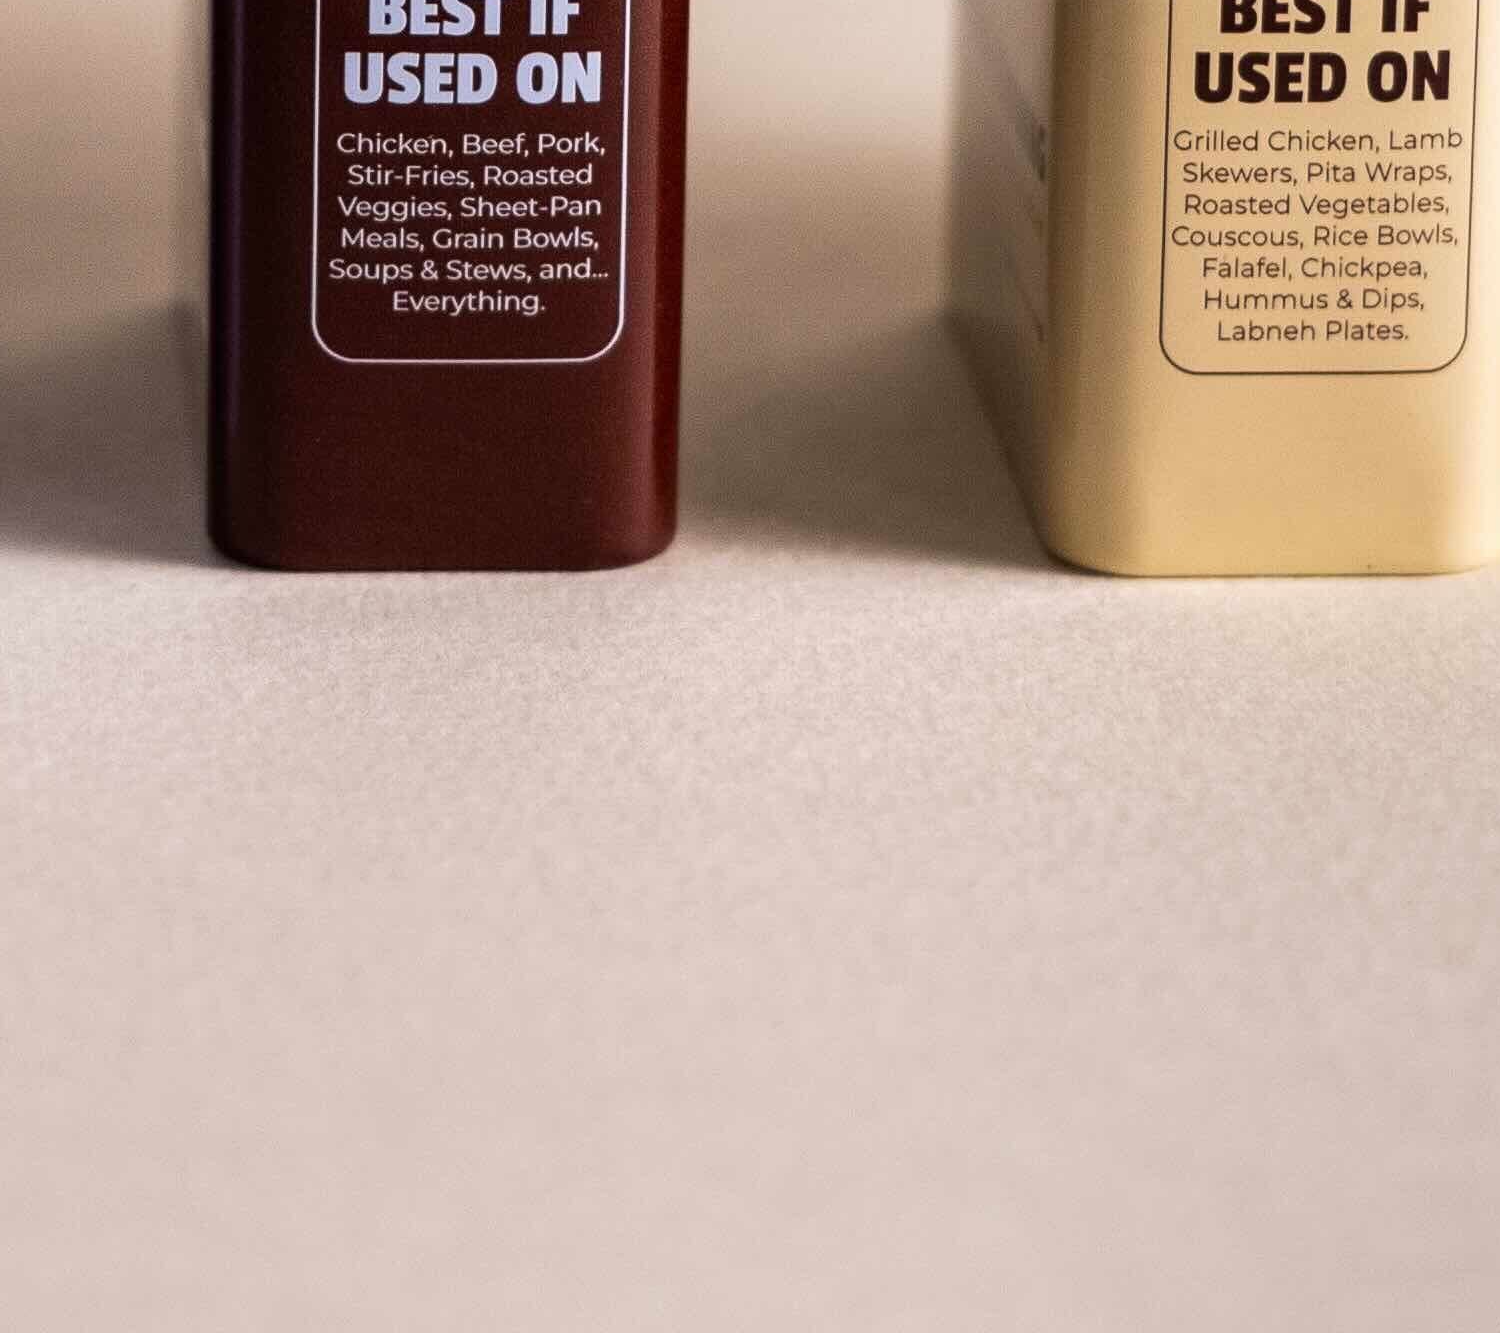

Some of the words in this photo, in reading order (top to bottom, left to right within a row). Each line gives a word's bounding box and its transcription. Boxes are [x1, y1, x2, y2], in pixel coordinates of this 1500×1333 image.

[343, 51, 498, 105] USED
[515, 51, 602, 105] ON
[1193, 51, 1348, 104] USED
[1366, 49, 1451, 103] ON
[336, 132, 454, 158] Chicken,
[462, 132, 529, 158] Beef,
[537, 131, 606, 156] Pork,
[1173, 129, 1259, 152] Grilled
[1267, 129, 1380, 154] Chicken,
[1389, 127, 1463, 151] Lamb
[347, 163, 475, 189] Stir-Fries,
[483, 162, 593, 186] Roasted
[1183, 161, 1298, 187] Skewers,
[1307, 161, 1356, 183] Pita
[1364, 161, 1453, 186] Wraps,
[337, 195, 453, 223] Veggies,
[460, 195, 602, 218] Sheet-Pan
[1184, 193, 1291, 216] Roasted
[1298, 192, 1449, 220] Vegetables,
